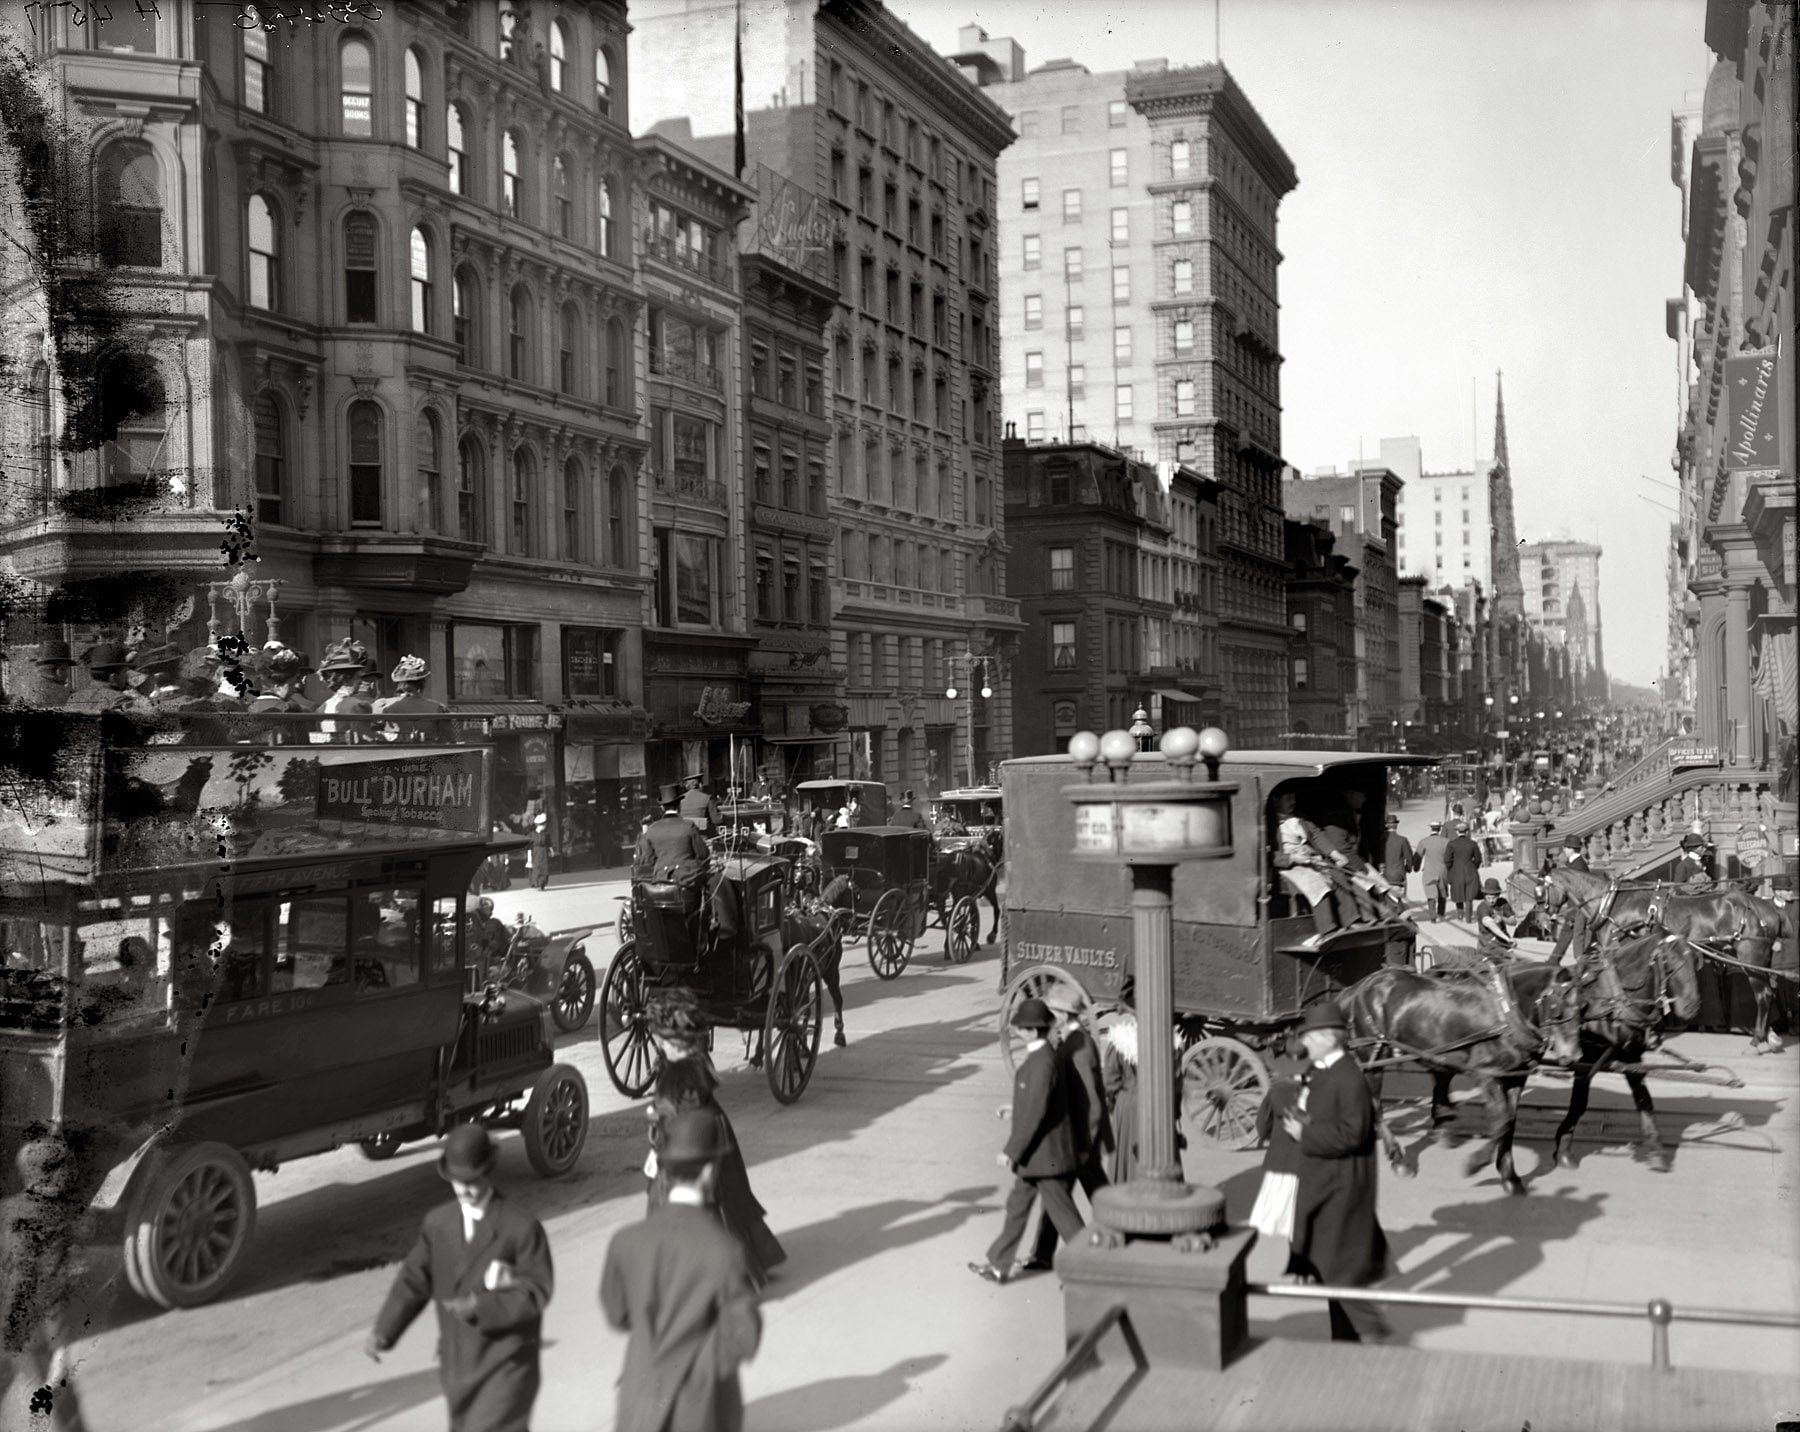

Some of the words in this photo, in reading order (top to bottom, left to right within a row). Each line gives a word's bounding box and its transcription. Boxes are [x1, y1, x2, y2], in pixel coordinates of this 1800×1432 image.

[1732, 359, 1774, 465] Apollinaris
[383, 774, 473, 807] DURHAM
[241, 874, 287, 889] FIFTH
[288, 864, 353, 883] AVENUE
[1016, 940, 1062, 963] SILVER
[226, 1000, 283, 1024] FARE
